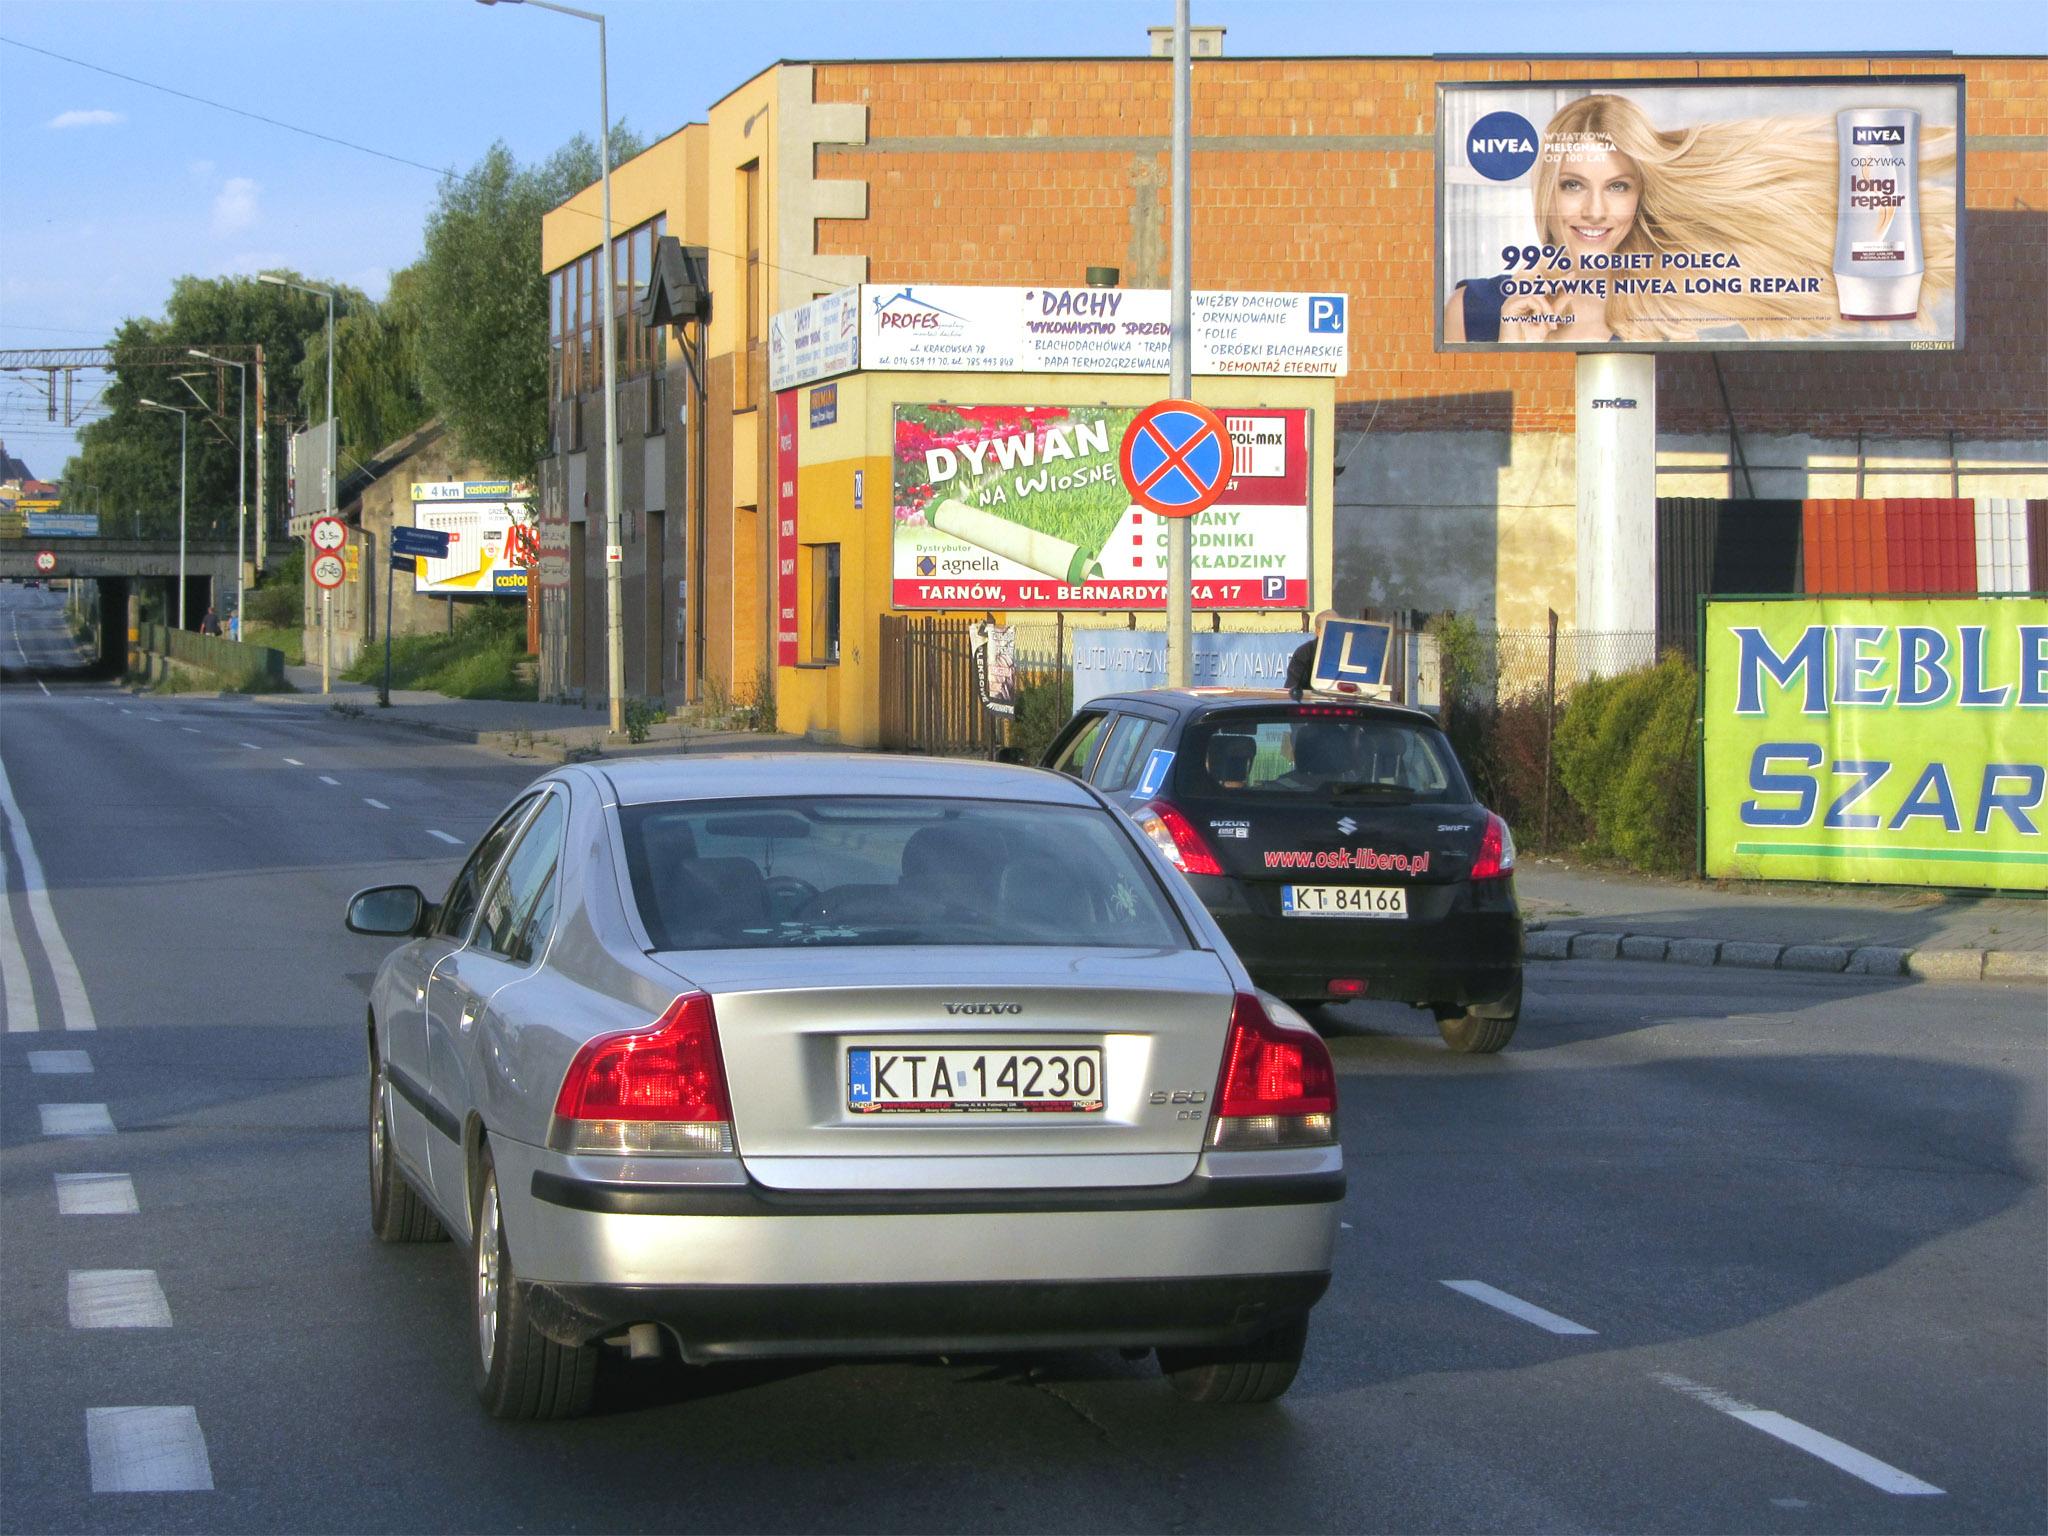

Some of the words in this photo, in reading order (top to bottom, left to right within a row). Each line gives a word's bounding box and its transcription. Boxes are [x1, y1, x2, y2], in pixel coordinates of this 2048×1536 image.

[1856, 130, 1901, 141] NIVEA
[1472, 138, 1534, 153] NIVEA
[1544, 153, 1561, 163] OD
[1565, 153, 1583, 163] 100
[1851, 175, 1895, 195] long
[1851, 195, 1906, 210] repair
[1501, 245, 1572, 271] 99%
[1580, 253, 1654, 269] KOBIET
[1661, 252, 1741, 269] POLECA
[1501, 274, 1607, 298] ODŻYWKĘ
[1614, 278, 1678, 294] NIVEA
[1685, 278, 1742, 294] LONG
[1042, 290, 1122, 317] DACHY
[1242, 296, 1299, 308] DACHOWE
[880, 312, 940, 330] PROFES
[1202, 312, 1287, 324] ORYNNOWANIE
[1313, 300, 1334, 330] P
[1502, 313, 1576, 324] www.NIVEA.pl
[1030, 321, 1116, 335] WYKONAWSTWO
[1205, 328, 1237, 339] FOLIE
[923, 345, 973, 354] KRAKOWSKA
[975, 345, 986, 354] 78
[1035, 339, 1131, 351] BLACHODACHÓWKA
[1211, 342, 1262, 355] OBRÓBKI
[1266, 345, 1343, 357] BLACHARSKIE
[1219, 358, 1280, 373] DEMONTAŻ
[1284, 361, 1337, 373] ETERNITU
[925, 419, 1110, 484] DYWAN
[431, 486, 438, 496] 4
[442, 485, 460, 496] km
[979, 485, 1007, 507] NA
[916, 543, 972, 554] Dystrybutor
[941, 556, 1000, 574] agnella
[918, 582, 1007, 603] TARNÓW,
[1019, 586, 1050, 600] UL.
[1220, 586, 1242, 599] 17
[1267, 578, 1283, 598] P
[1338, 632, 1367, 674] L
[1437, 824, 1471, 832] SWIFT
[1264, 847, 1430, 877] www.osk-libero.pl
[1296, 888, 1326, 909] KT
[1336, 889, 1401, 911] 84166
[943, 1002, 1023, 1015] VOLVO
[874, 1056, 955, 1098] KTA
[972, 1055, 1096, 1098] 14230
[853, 1083, 869, 1095] PL
